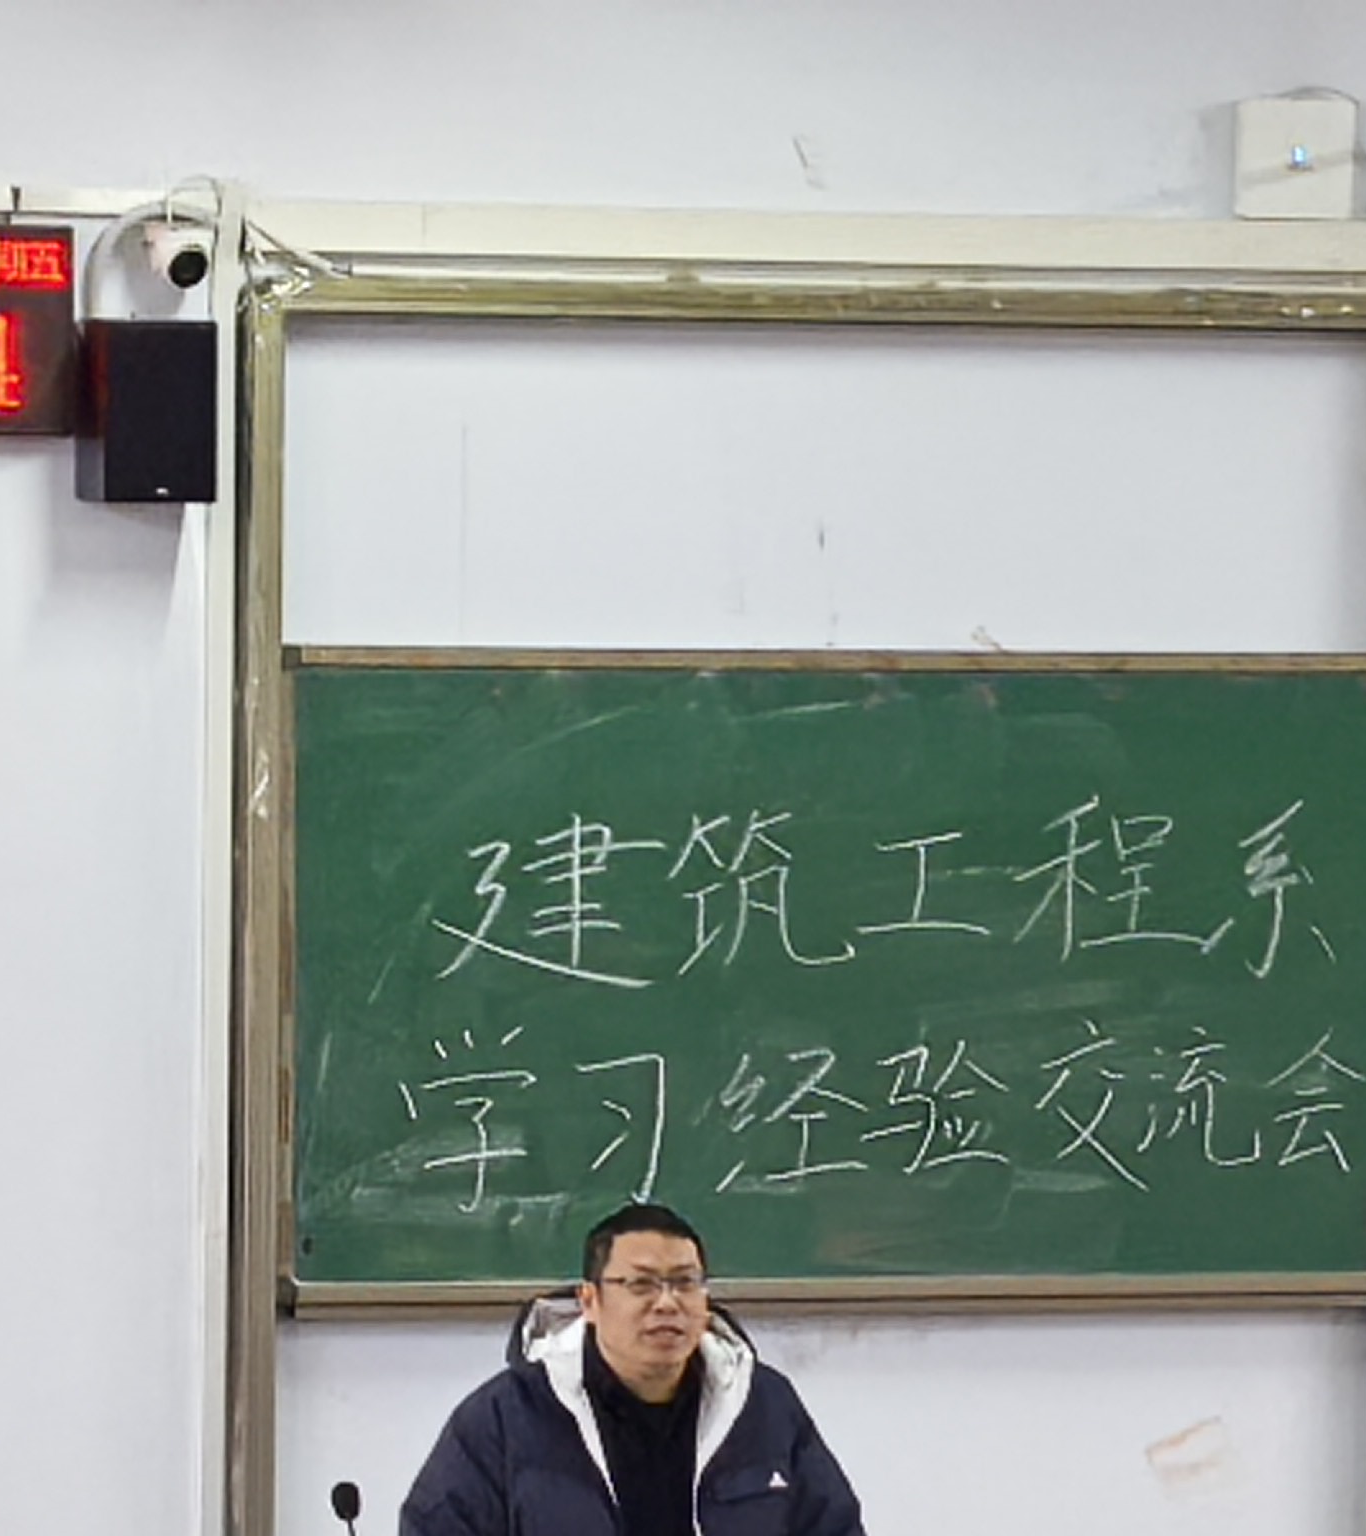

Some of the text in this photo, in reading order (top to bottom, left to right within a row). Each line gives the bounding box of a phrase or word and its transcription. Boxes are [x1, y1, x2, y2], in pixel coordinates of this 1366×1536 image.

[433, 795, 1337, 987] 建筑工程系
[399, 1019, 1366, 1213] 学习经验交流会
